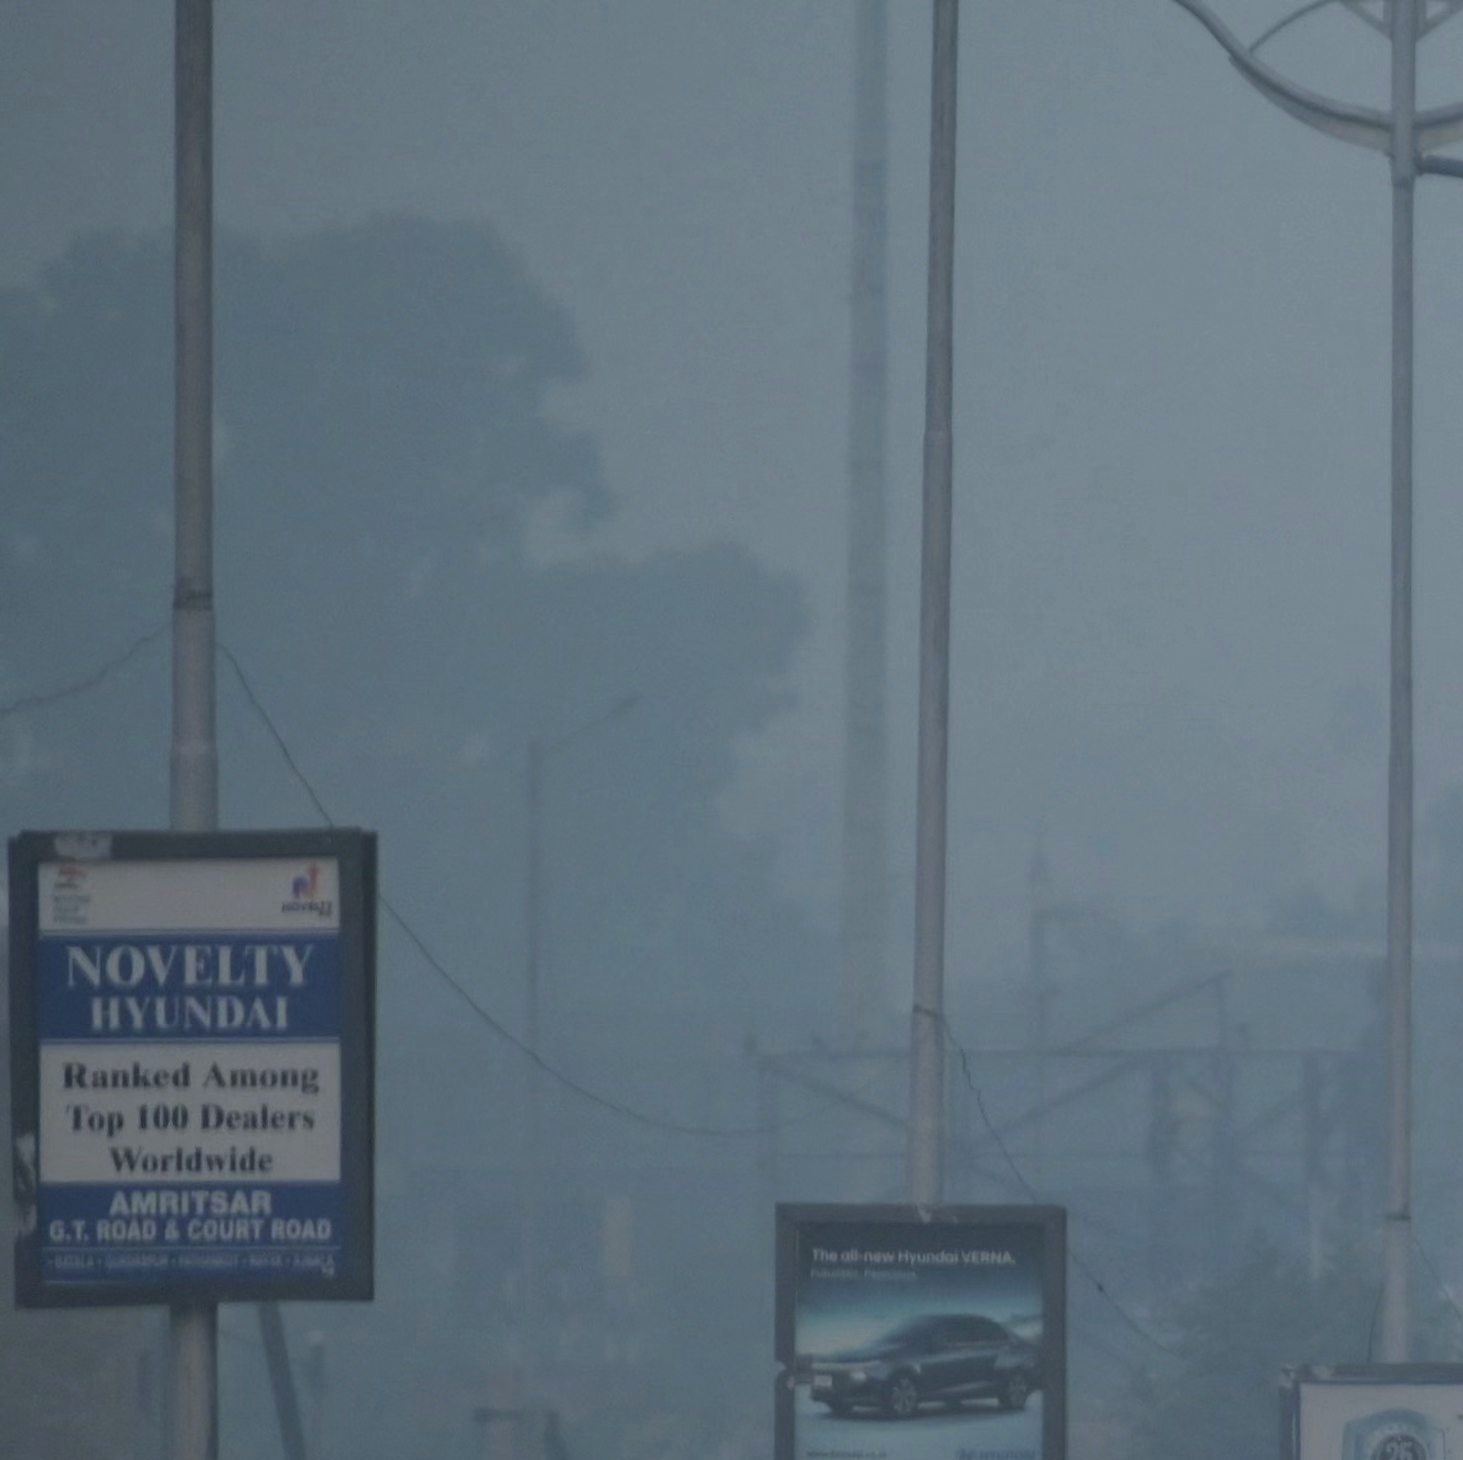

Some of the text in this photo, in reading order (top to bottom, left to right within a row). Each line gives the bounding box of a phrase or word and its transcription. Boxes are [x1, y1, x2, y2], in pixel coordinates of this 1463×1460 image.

[66, 944, 314, 988] NOVELTY
[91, 995, 289, 1031] HYUNDAI
[62, 1061, 321, 1095] Ranked Among
[66, 1103, 316, 1138] Top 100 Dealers
[109, 1146, 274, 1174] Worldwide
[109, 1190, 272, 1216] AMRITSAR
[50, 1218, 332, 1241] G.T. ROAD & COURT ROAD
[812, 1248, 838, 1262] The
[841, 1248, 895, 1262] all-new
[898, 1249, 959, 1265] Hyundai
